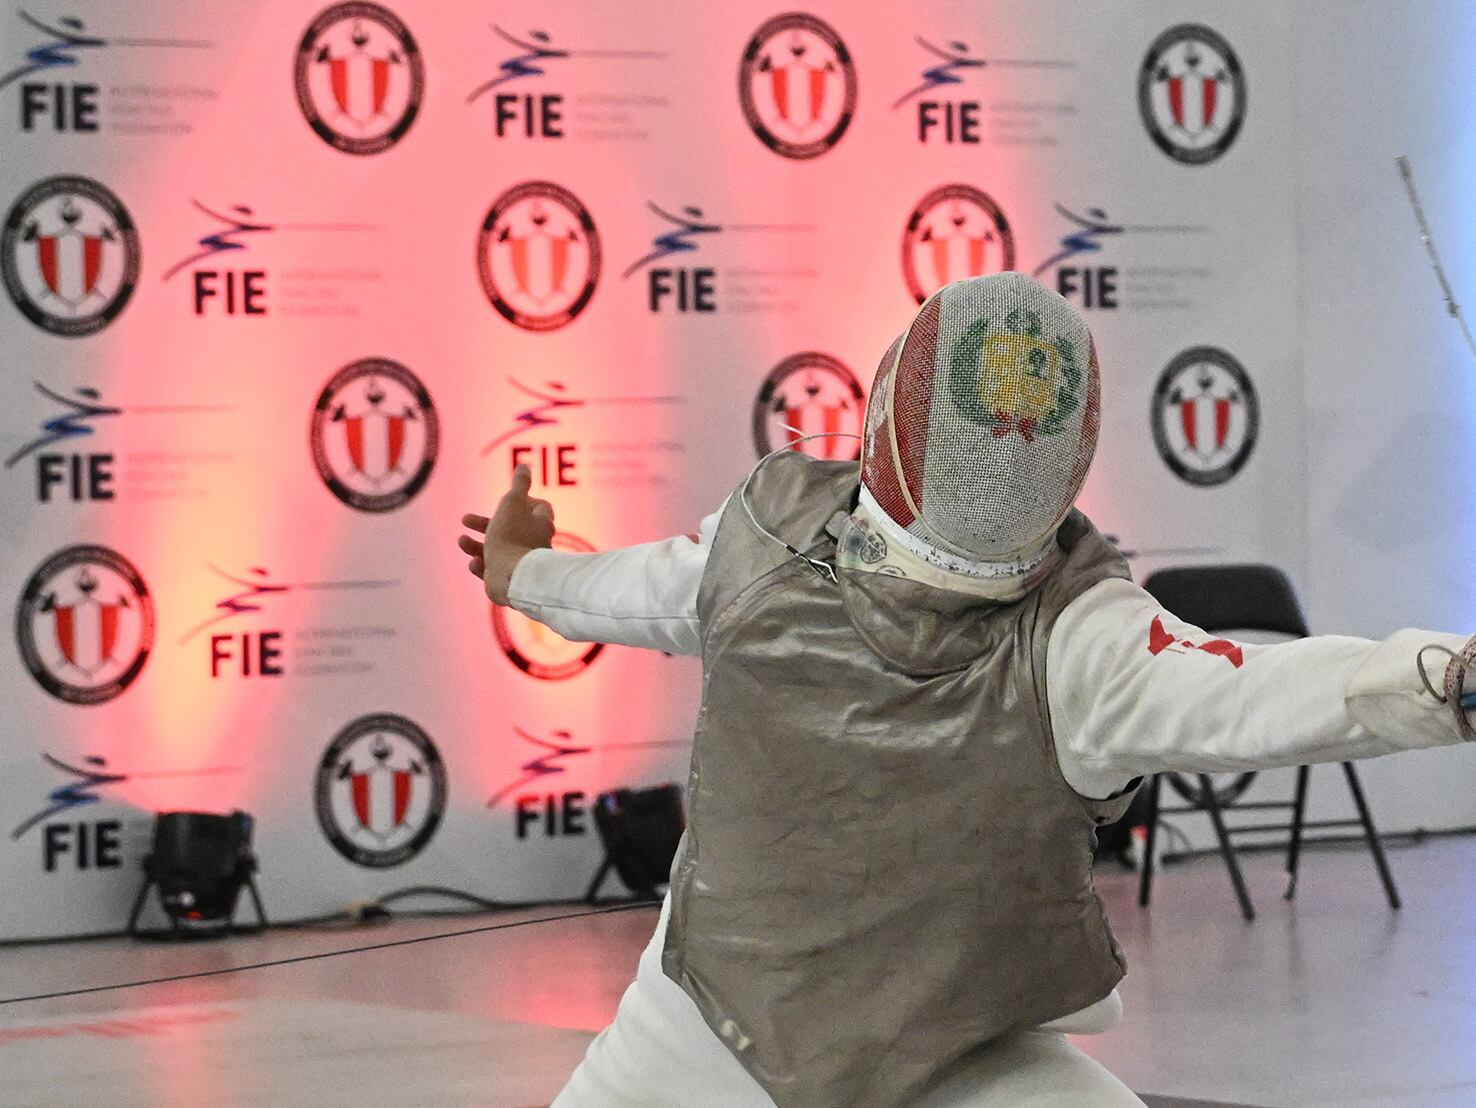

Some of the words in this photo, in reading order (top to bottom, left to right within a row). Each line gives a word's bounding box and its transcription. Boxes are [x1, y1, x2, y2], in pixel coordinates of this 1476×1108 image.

[21, 83, 99, 132] FIE
[494, 93, 565, 139] FIE
[917, 101, 981, 145] FIE
[193, 270, 267, 316] FIE
[648, 267, 717, 313] FIE
[1056, 266, 1119, 310] FIE
[36, 453, 115, 503] FIE
[210, 630, 284, 679] FIE
[514, 790, 588, 840] FIE
[43, 820, 123, 873] FIE
